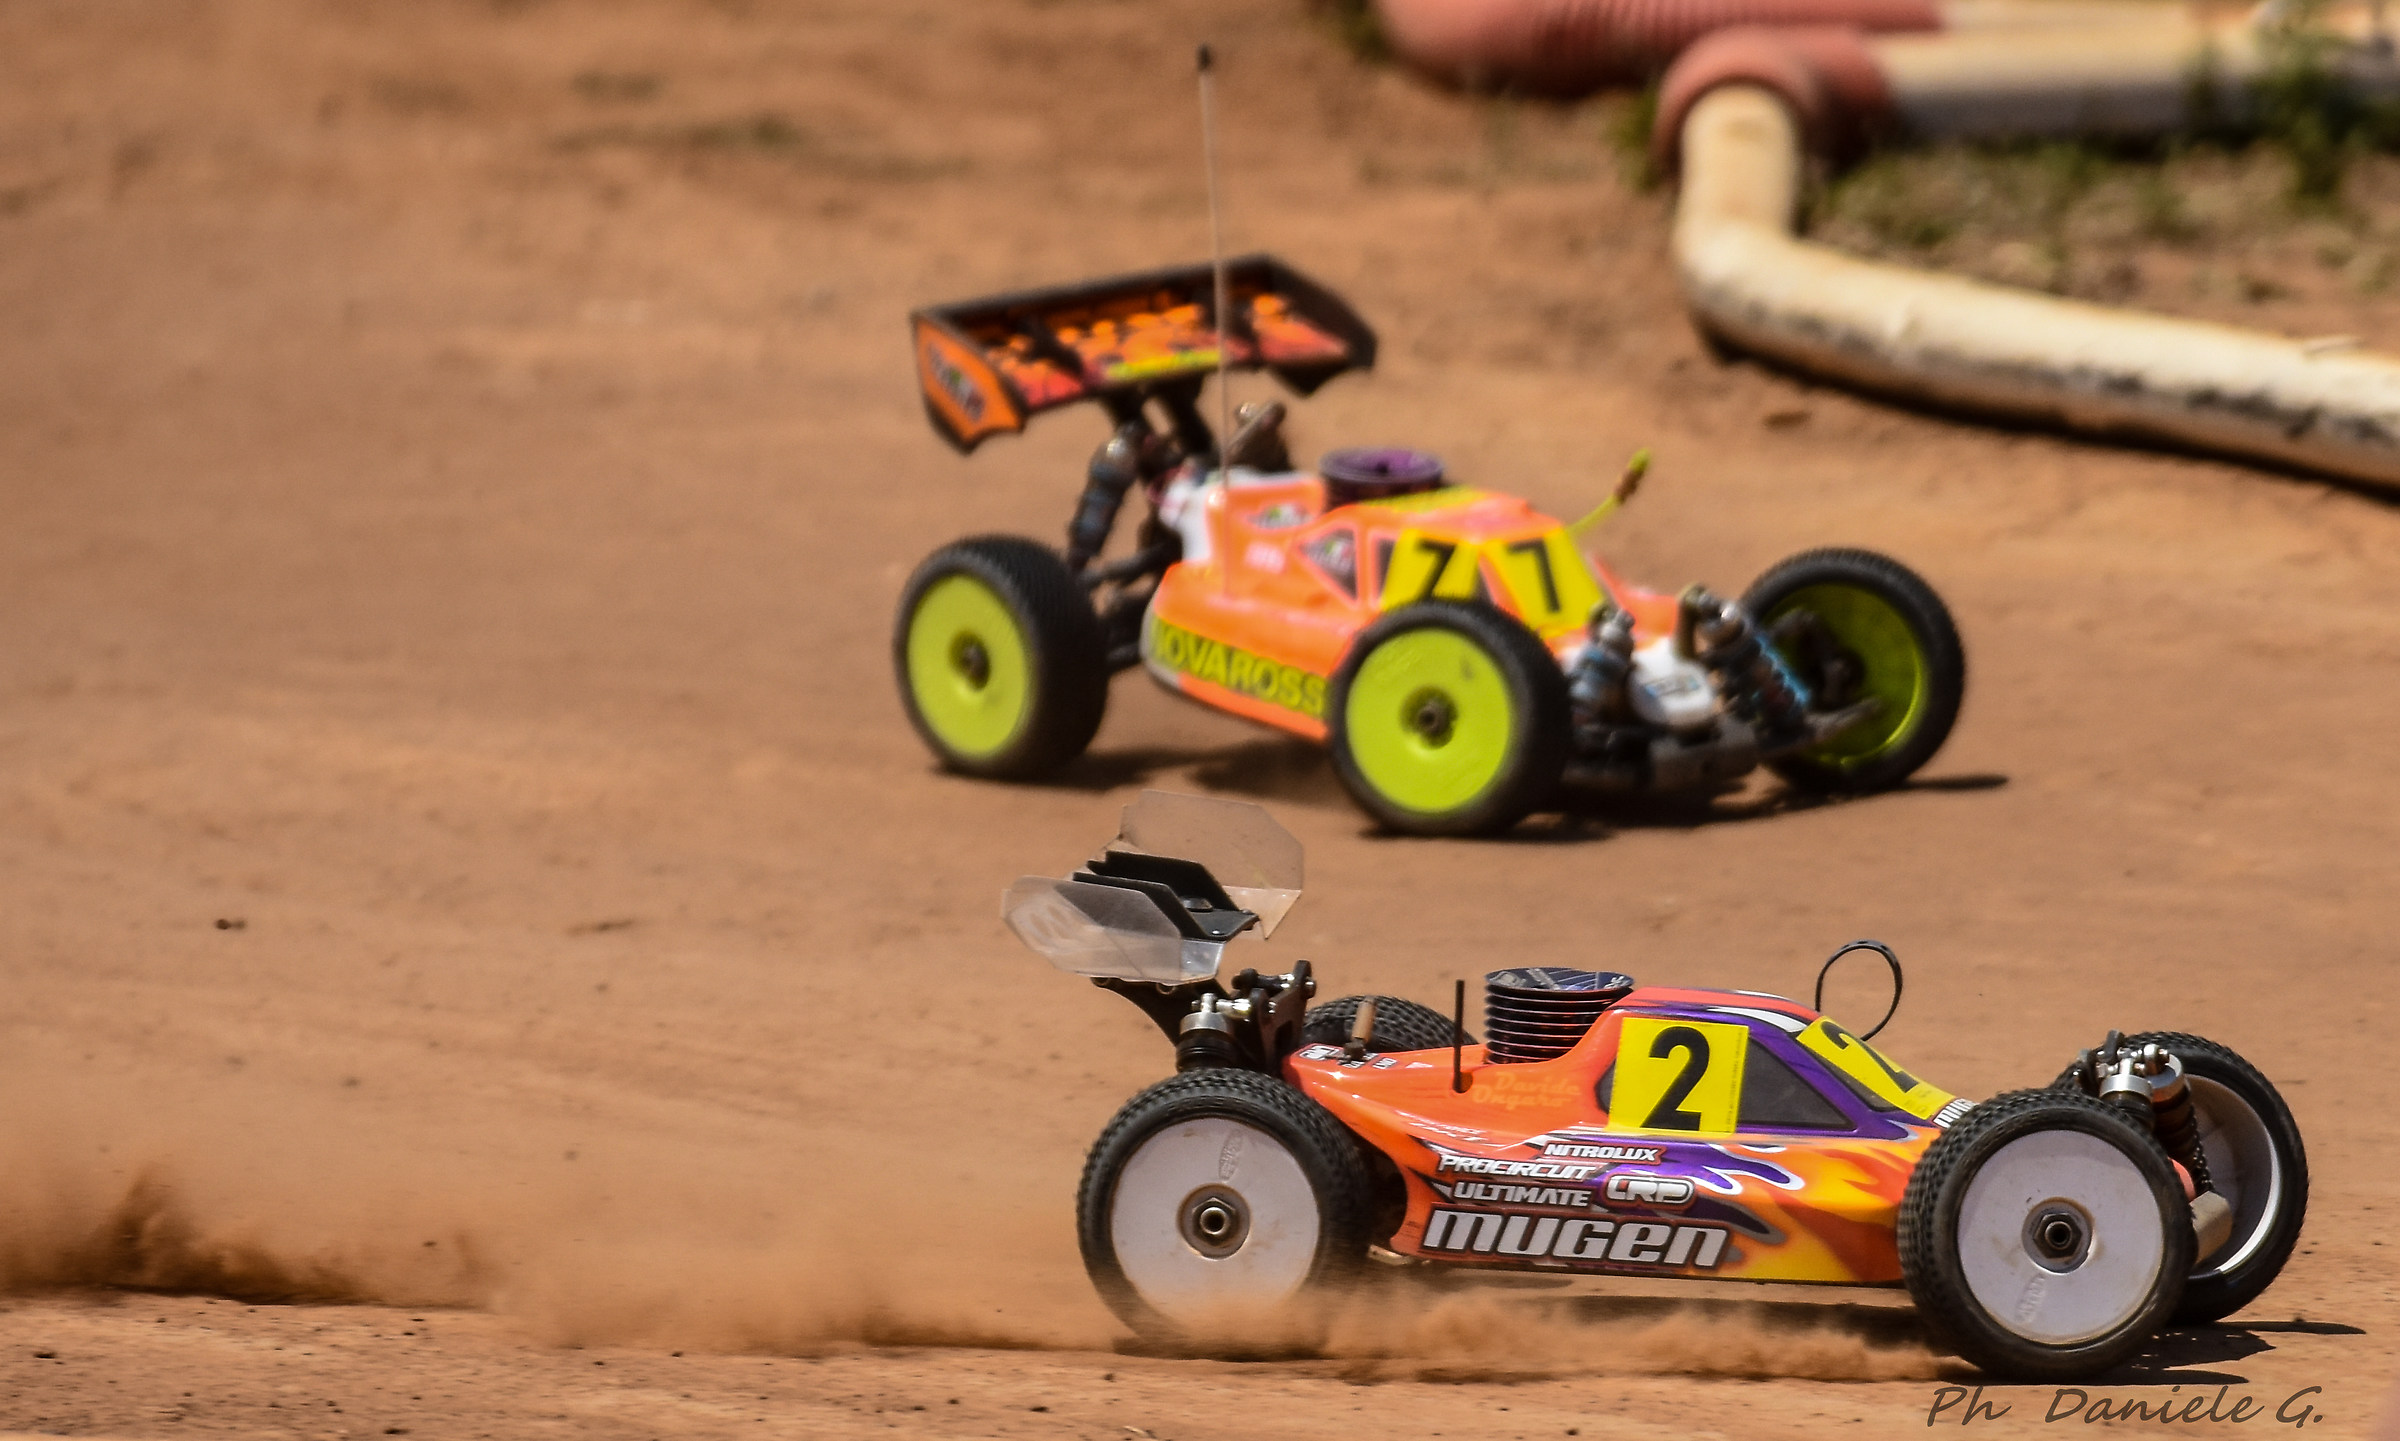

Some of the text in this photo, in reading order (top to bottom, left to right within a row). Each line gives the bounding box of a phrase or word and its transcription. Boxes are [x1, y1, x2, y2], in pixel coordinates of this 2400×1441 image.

[1418, 539, 1457, 599] 7
[1508, 539, 1561, 614] 7
[1640, 1026, 1710, 1131] 2
[1821, 1021, 1919, 1093] 2
[1438, 1155, 1596, 1180] PROCIRCUIT
[1543, 1144, 1658, 1161] NITROLUX
[1454, 1181, 1592, 1207] ULTIMATE
